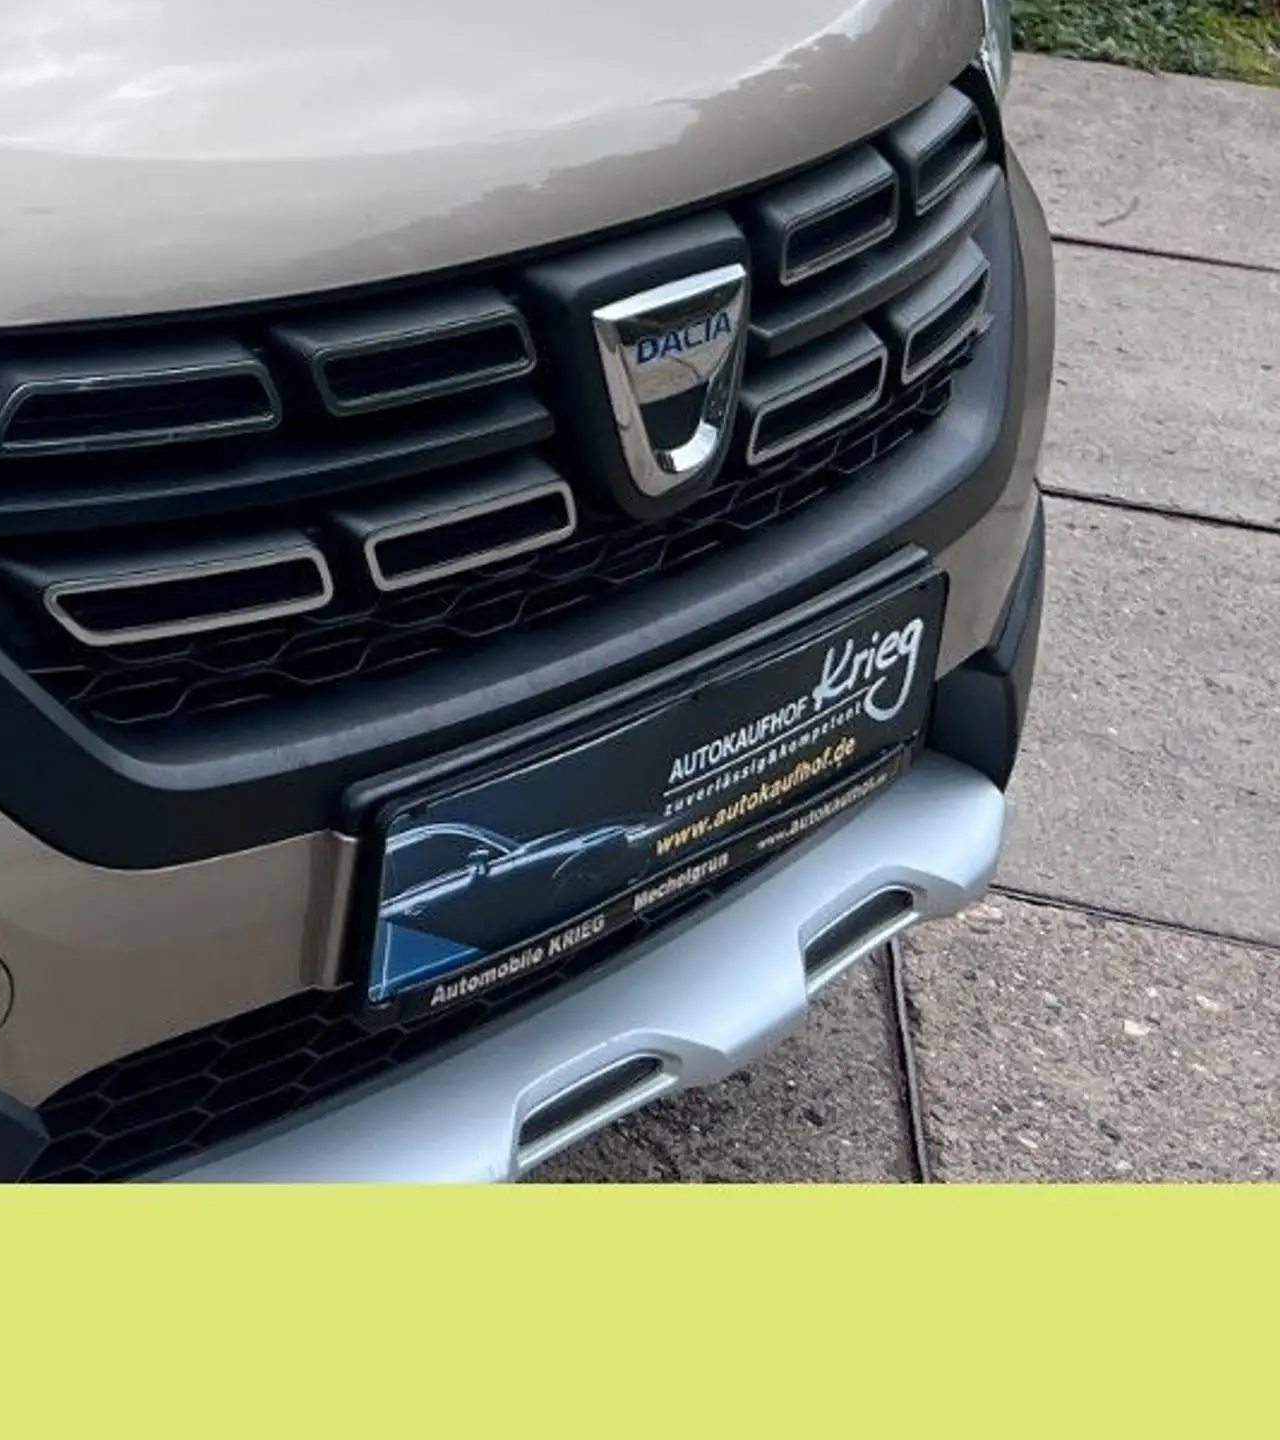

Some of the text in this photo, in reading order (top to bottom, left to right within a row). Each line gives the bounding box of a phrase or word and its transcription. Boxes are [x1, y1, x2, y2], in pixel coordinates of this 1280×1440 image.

[636, 311, 732, 365] DACIA
[668, 617, 924, 784] AUTOKAUFHOF Krieg
[656, 735, 856, 856] www.autokaufhof.de
[548, 914, 606, 957] KRIEG
